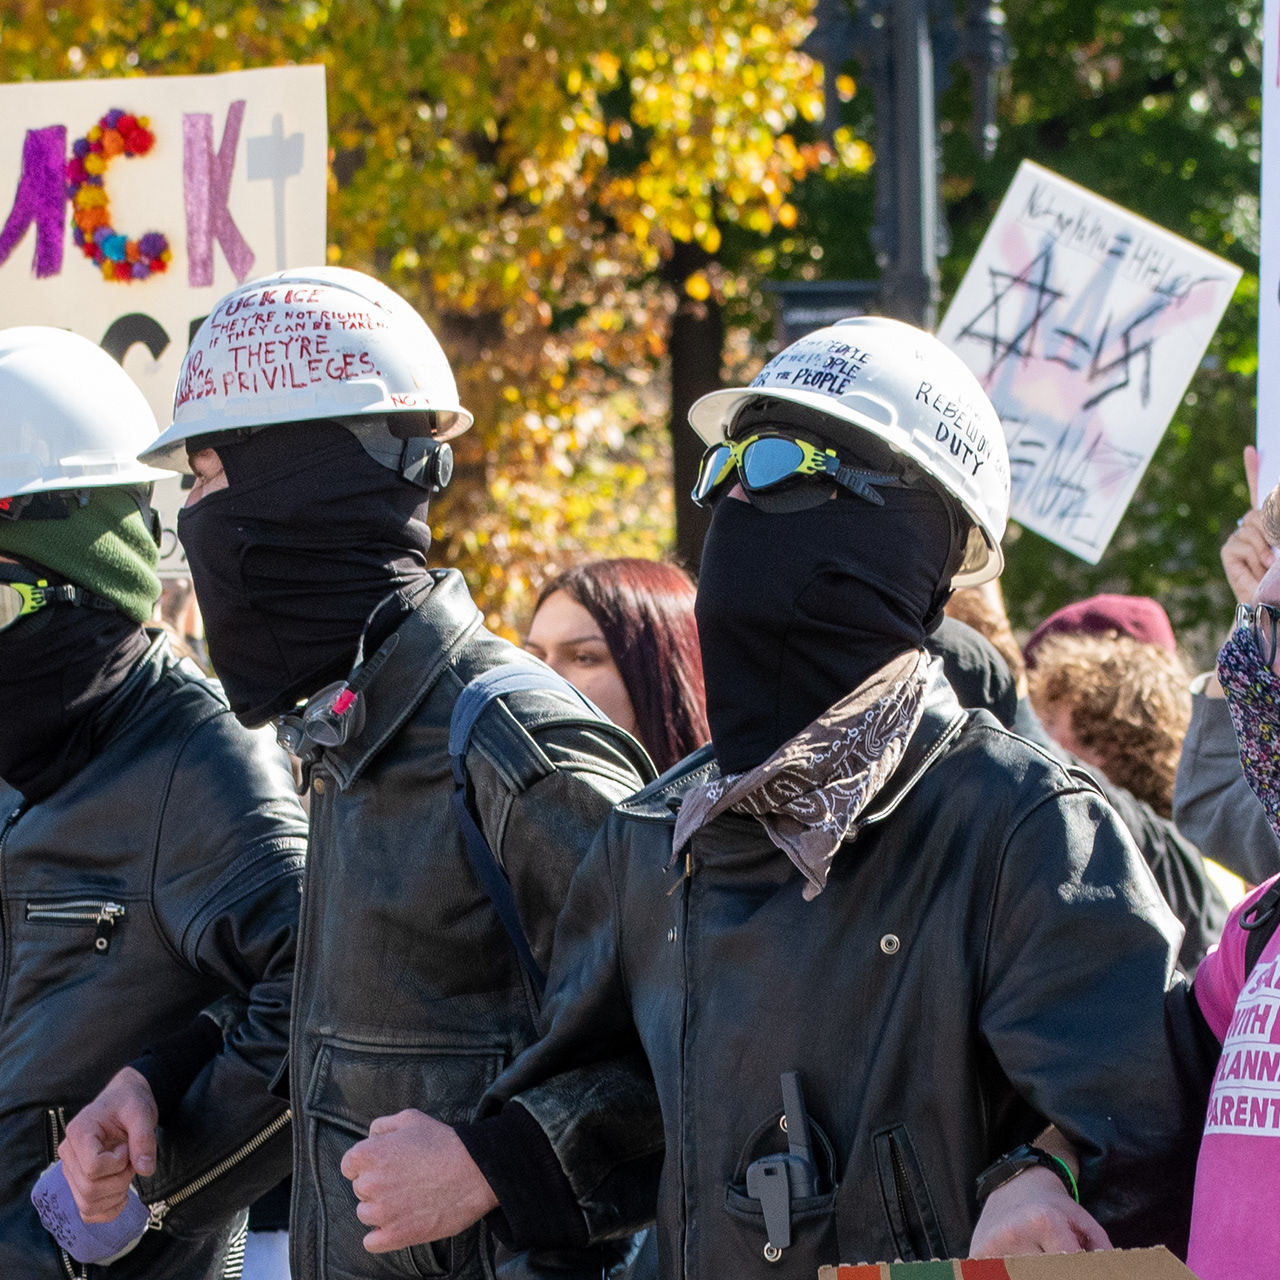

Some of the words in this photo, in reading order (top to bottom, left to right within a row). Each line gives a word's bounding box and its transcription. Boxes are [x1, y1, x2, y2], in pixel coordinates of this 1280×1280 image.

[210, 311, 276, 335] THEY'RE
[285, 310, 317, 320] NOT
[211, 290, 277, 323] FUCK
[209, 336, 219, 349] IF
[227, 325, 268, 344] THEY
[274, 323, 305, 335] CAN
[313, 321, 331, 331] BE
[228, 335, 330, 373] THEY'RE
[223, 352, 382, 396] PRIVILEGES.
[791, 368, 850, 395] PEOPLE
[935, 421, 984, 476] DUTY
